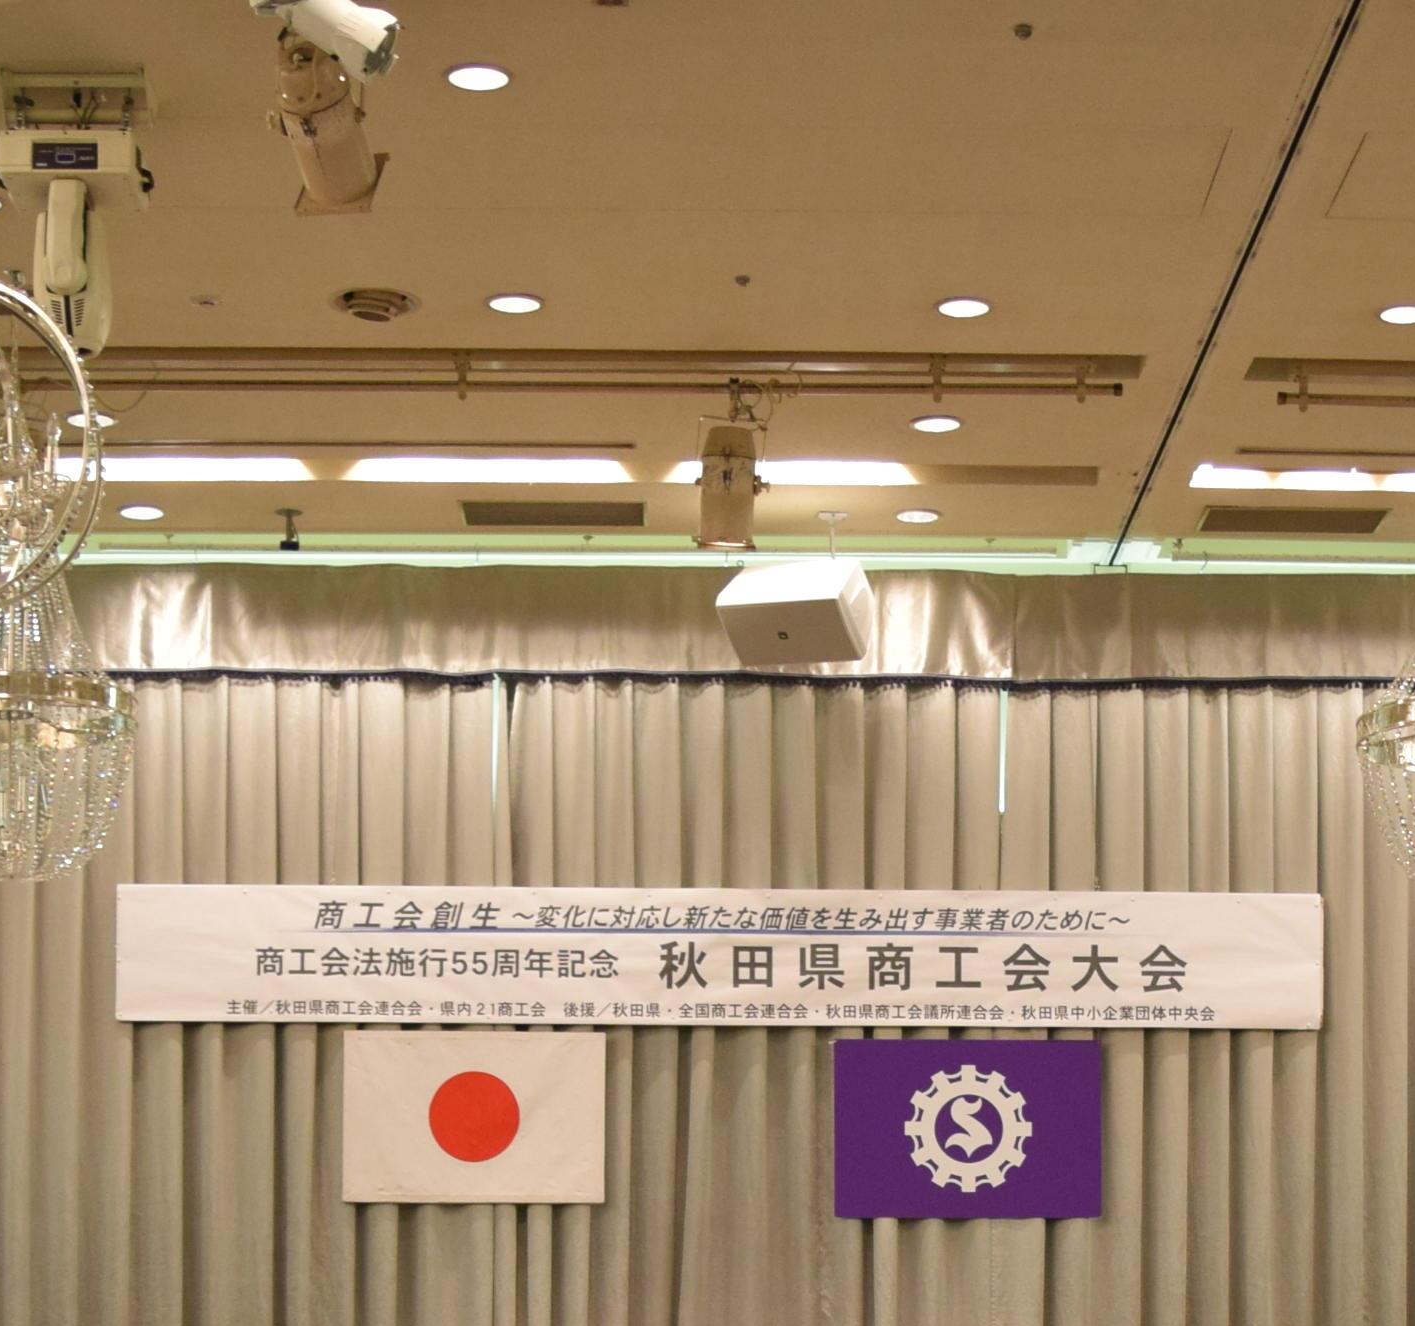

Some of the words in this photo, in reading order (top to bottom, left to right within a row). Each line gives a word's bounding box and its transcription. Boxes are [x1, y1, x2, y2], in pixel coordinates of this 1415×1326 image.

[256, 947, 619, 979] 商工会法施行55周年記念
[658, 940, 1188, 992] 秋田県商工会大会
